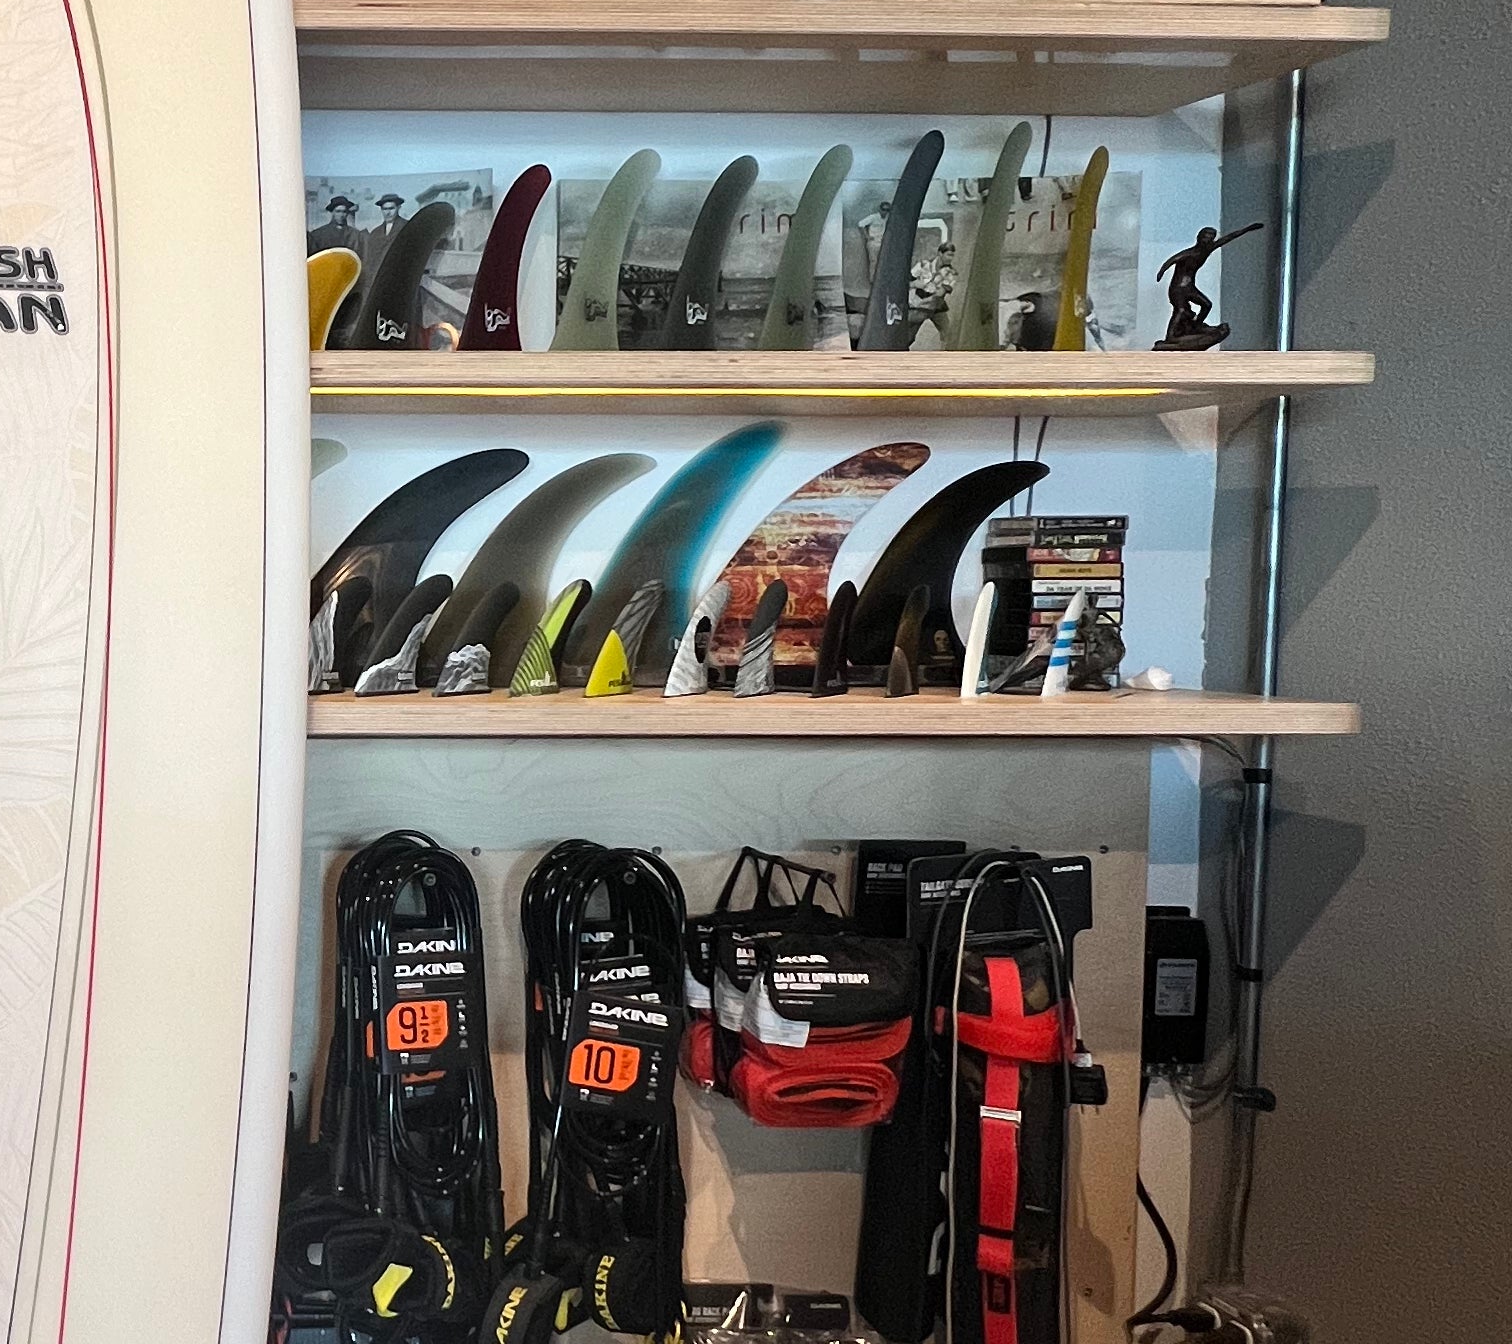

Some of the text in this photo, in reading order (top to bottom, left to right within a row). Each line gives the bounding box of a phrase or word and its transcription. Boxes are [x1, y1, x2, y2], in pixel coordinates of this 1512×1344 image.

[580, 931, 615, 943] INE
[396, 939, 458, 955] DAKIN
[393, 962, 466, 978] DAKINE
[588, 965, 650, 983] AKINE
[588, 1002, 669, 1027] DAKINE
[583, 1043, 616, 1084] 10
